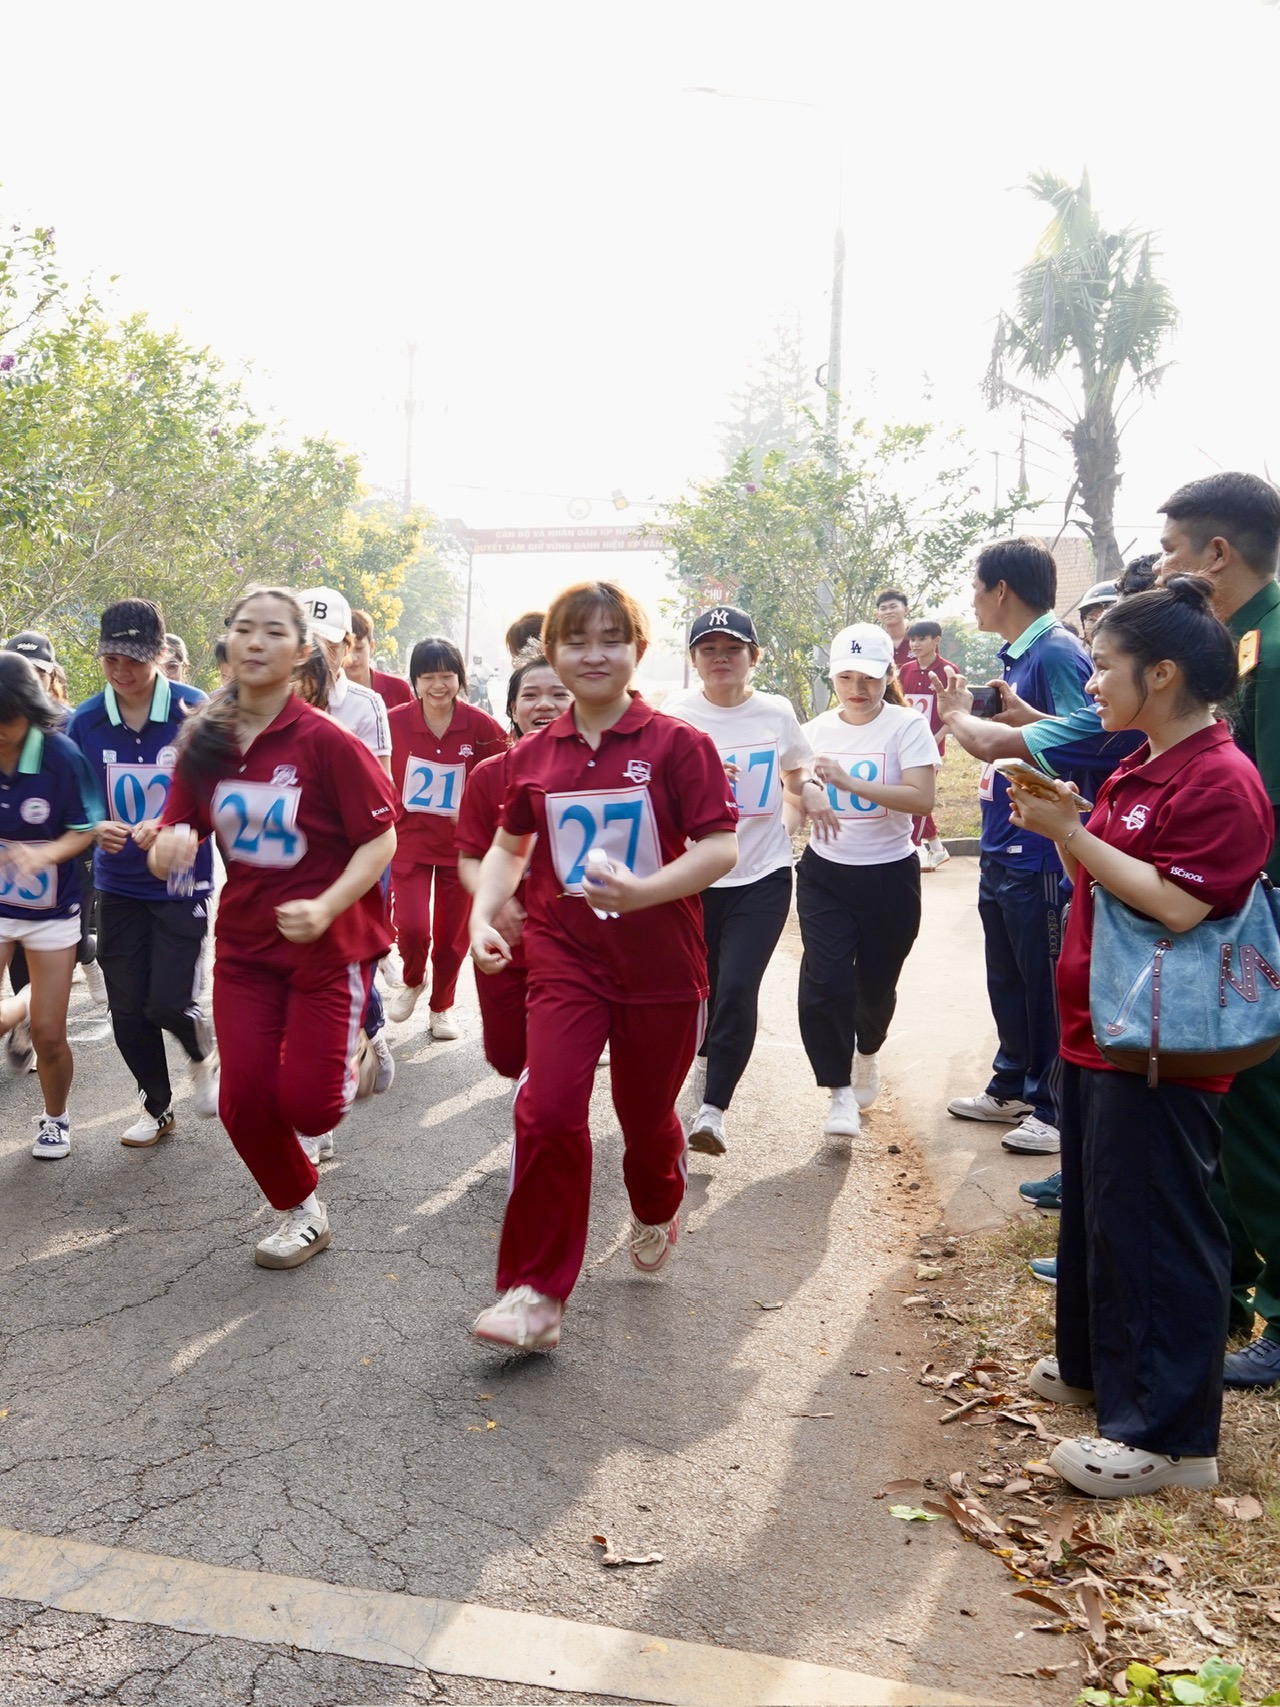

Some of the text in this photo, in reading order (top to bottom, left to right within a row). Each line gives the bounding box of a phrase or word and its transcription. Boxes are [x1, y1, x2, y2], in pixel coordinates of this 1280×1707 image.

[850, 640, 863, 654] LA
[407, 767, 458, 810] 21
[217, 792, 300, 857] 24
[558, 800, 644, 885] 27
